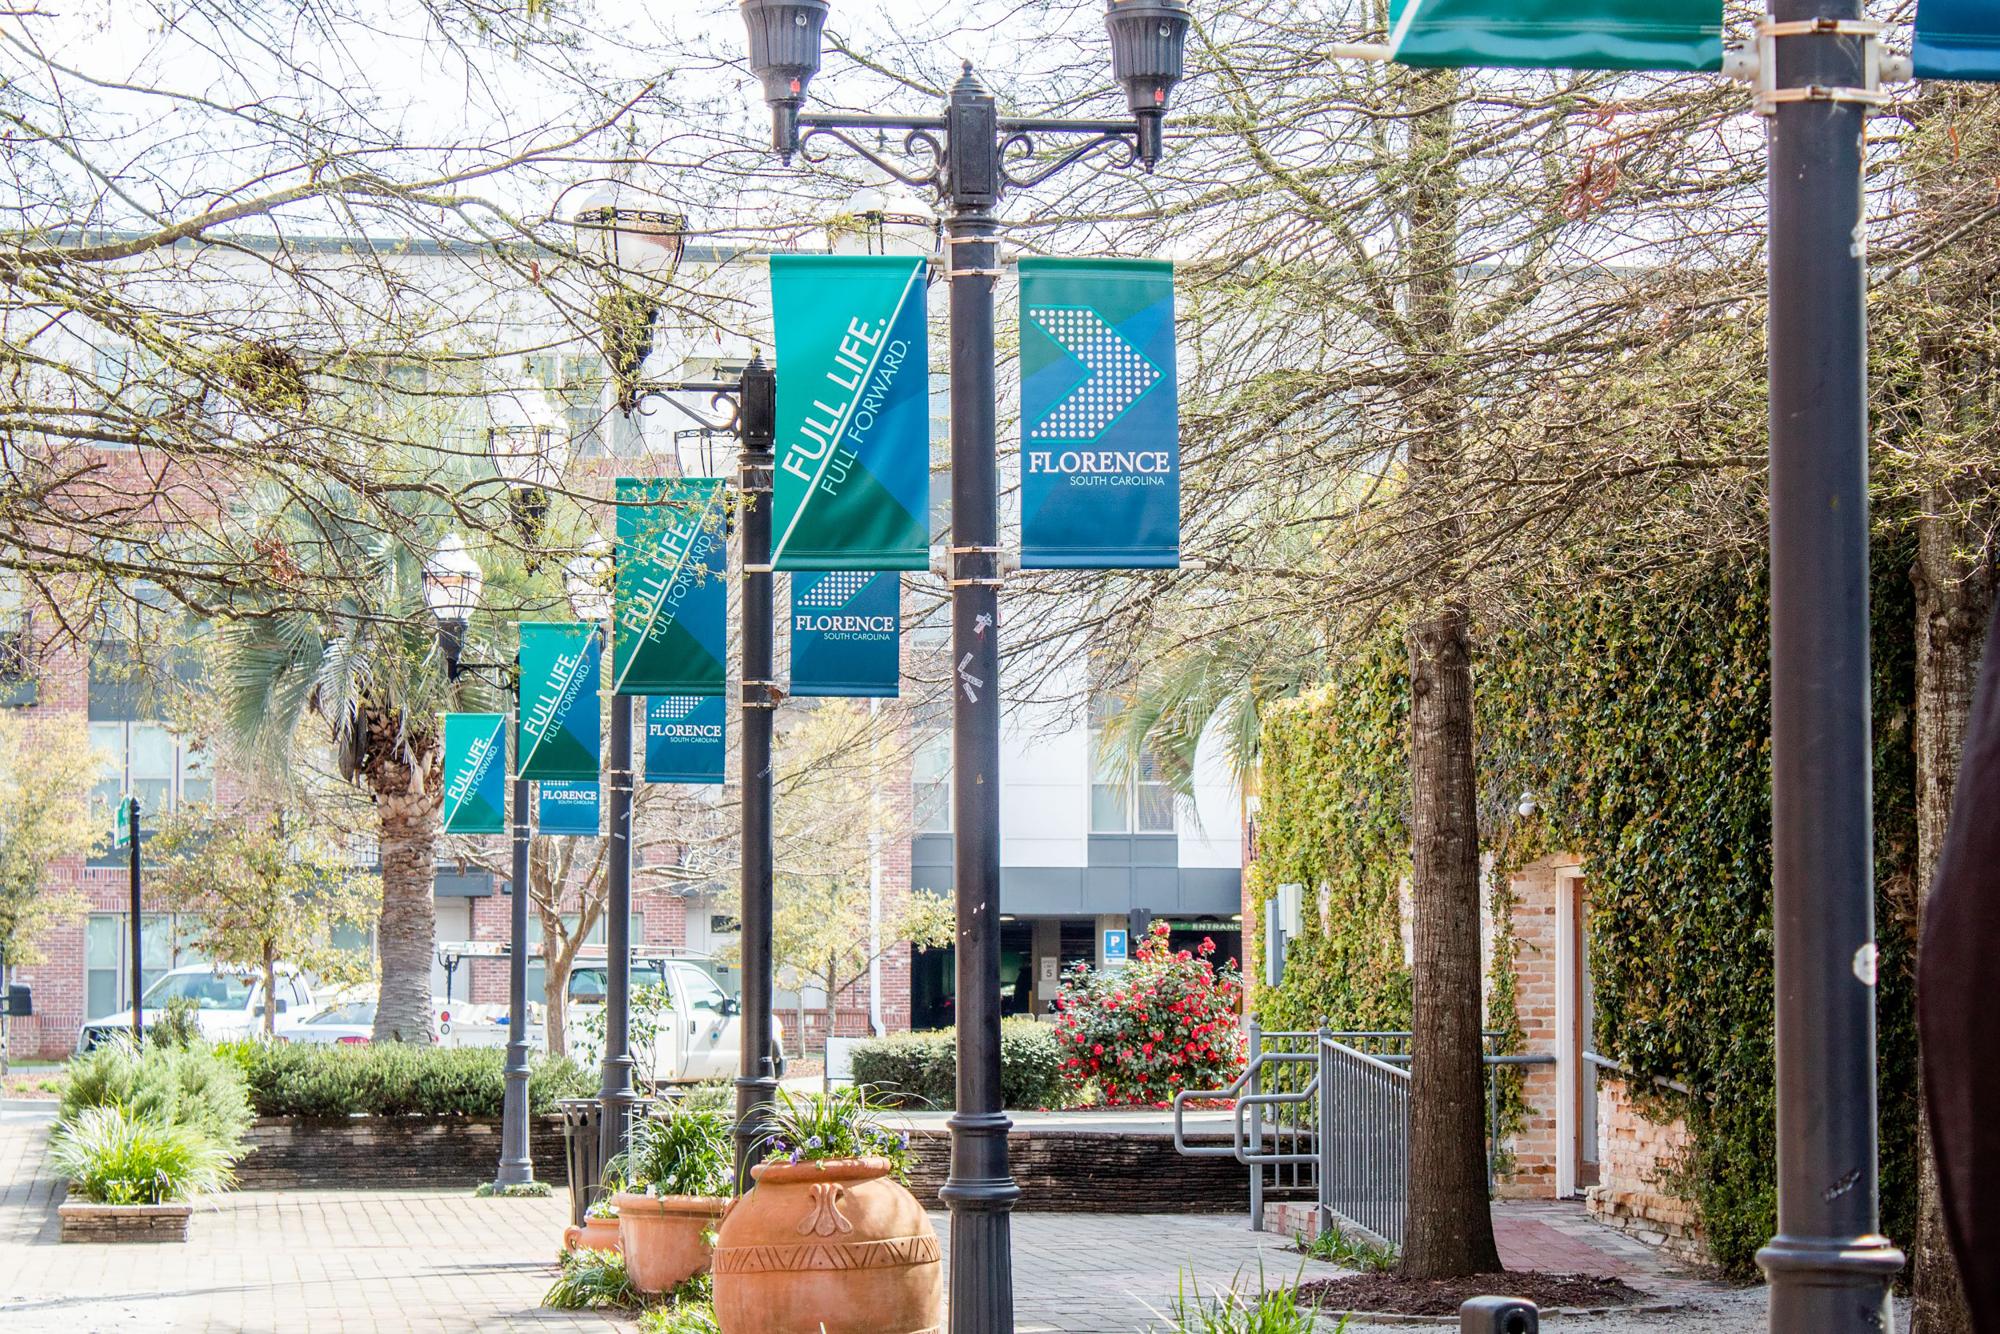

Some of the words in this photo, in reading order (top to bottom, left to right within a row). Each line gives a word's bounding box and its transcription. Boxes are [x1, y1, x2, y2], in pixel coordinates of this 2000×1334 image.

[782, 400, 847, 482] FULL
[826, 316, 886, 392] LIFE.
[821, 449, 858, 496] FULL
[847, 340, 911, 444] FORWARD.
[1029, 451, 1170, 473] FLORENCE
[1070, 476, 1107, 486] SOUTH
[1110, 476, 1165, 486] CAROLINA
[621, 577, 667, 634] FULL
[648, 611, 676, 644] FULL
[795, 615, 894, 632] FLORENCE
[824, 632, 850, 641] SOUTH
[852, 632, 890, 641] CAROLINA
[523, 695, 557, 736] FULL
[546, 653, 578, 691] LIFE.
[543, 719, 563, 744] FULL
[557, 664, 592, 718] FORWARD.
[649, 724, 722, 737] FLORENCE
[447, 768, 473, 800] FULL
[464, 737, 489, 767] LIFE.
[462, 785, 478, 806] FULL
[542, 790, 597, 801] FLORENCE
[1110, 936, 1120, 947] P
[1046, 969, 1053, 978] 5
